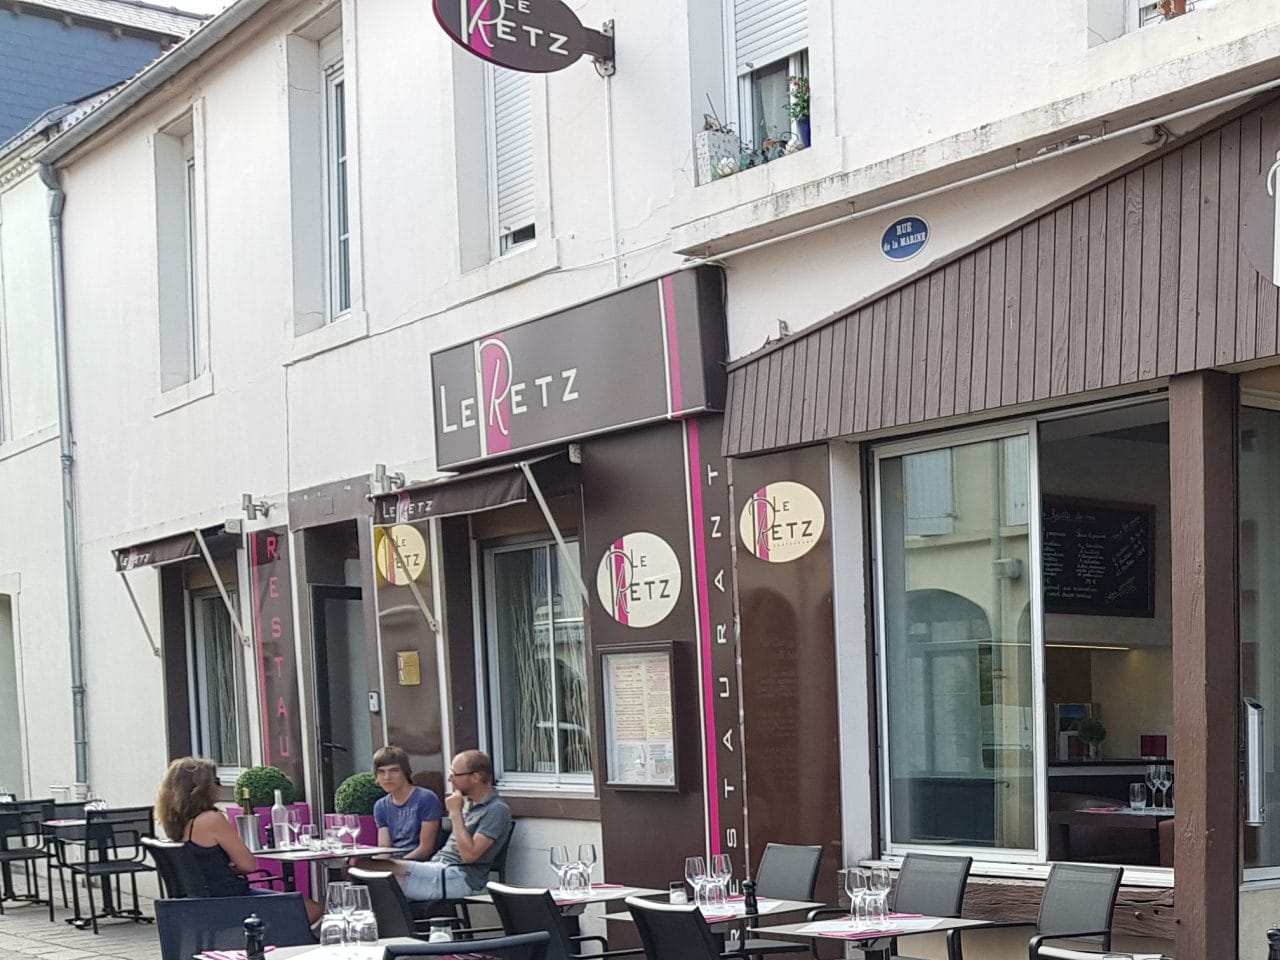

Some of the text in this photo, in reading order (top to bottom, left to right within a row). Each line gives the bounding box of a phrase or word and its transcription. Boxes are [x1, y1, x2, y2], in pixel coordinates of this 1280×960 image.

[460, 0, 569, 55] RETZ
[892, 240, 899, 249] la
[900, 232, 926, 247] MARINE
[896, 222, 912, 236] RUE
[440, 338, 580, 458] LE RETZ
[749, 497, 813, 556] RETZ
[773, 496, 790, 512] LE
[606, 550, 671, 617] RETZ
[631, 549, 647, 568] LE
[707, 464, 741, 942] RESTAURANT
